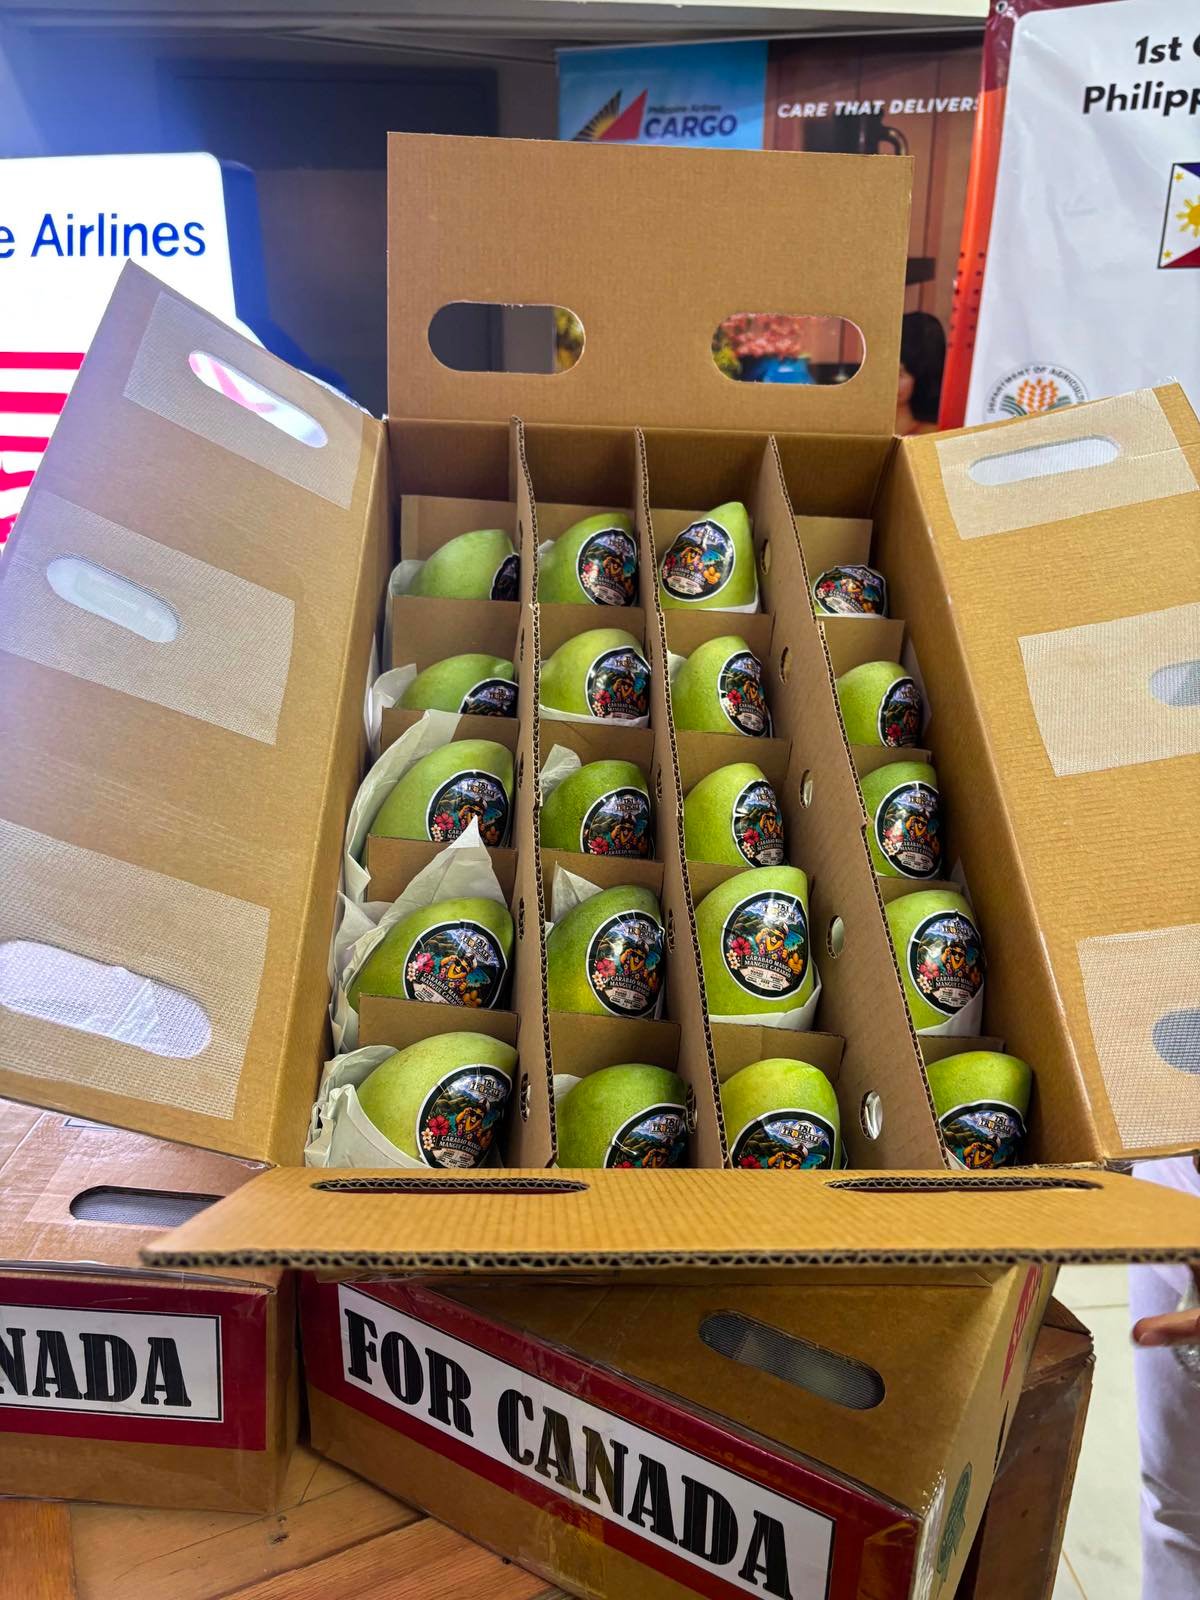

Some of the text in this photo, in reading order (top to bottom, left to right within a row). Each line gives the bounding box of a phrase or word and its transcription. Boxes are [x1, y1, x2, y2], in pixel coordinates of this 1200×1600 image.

[1135, 35, 1182, 64] 1st
[777, 102, 828, 118] CARE
[834, 100, 885, 116] THAT
[644, 114, 738, 138] CARGO
[30, 212, 206, 257] Airlines
[745, 954, 773, 965] CARABAO
[798, 1123, 813, 1133] TSI
[344, 1308, 474, 1438] FOR
[498, 1388, 794, 1600] CANADA
